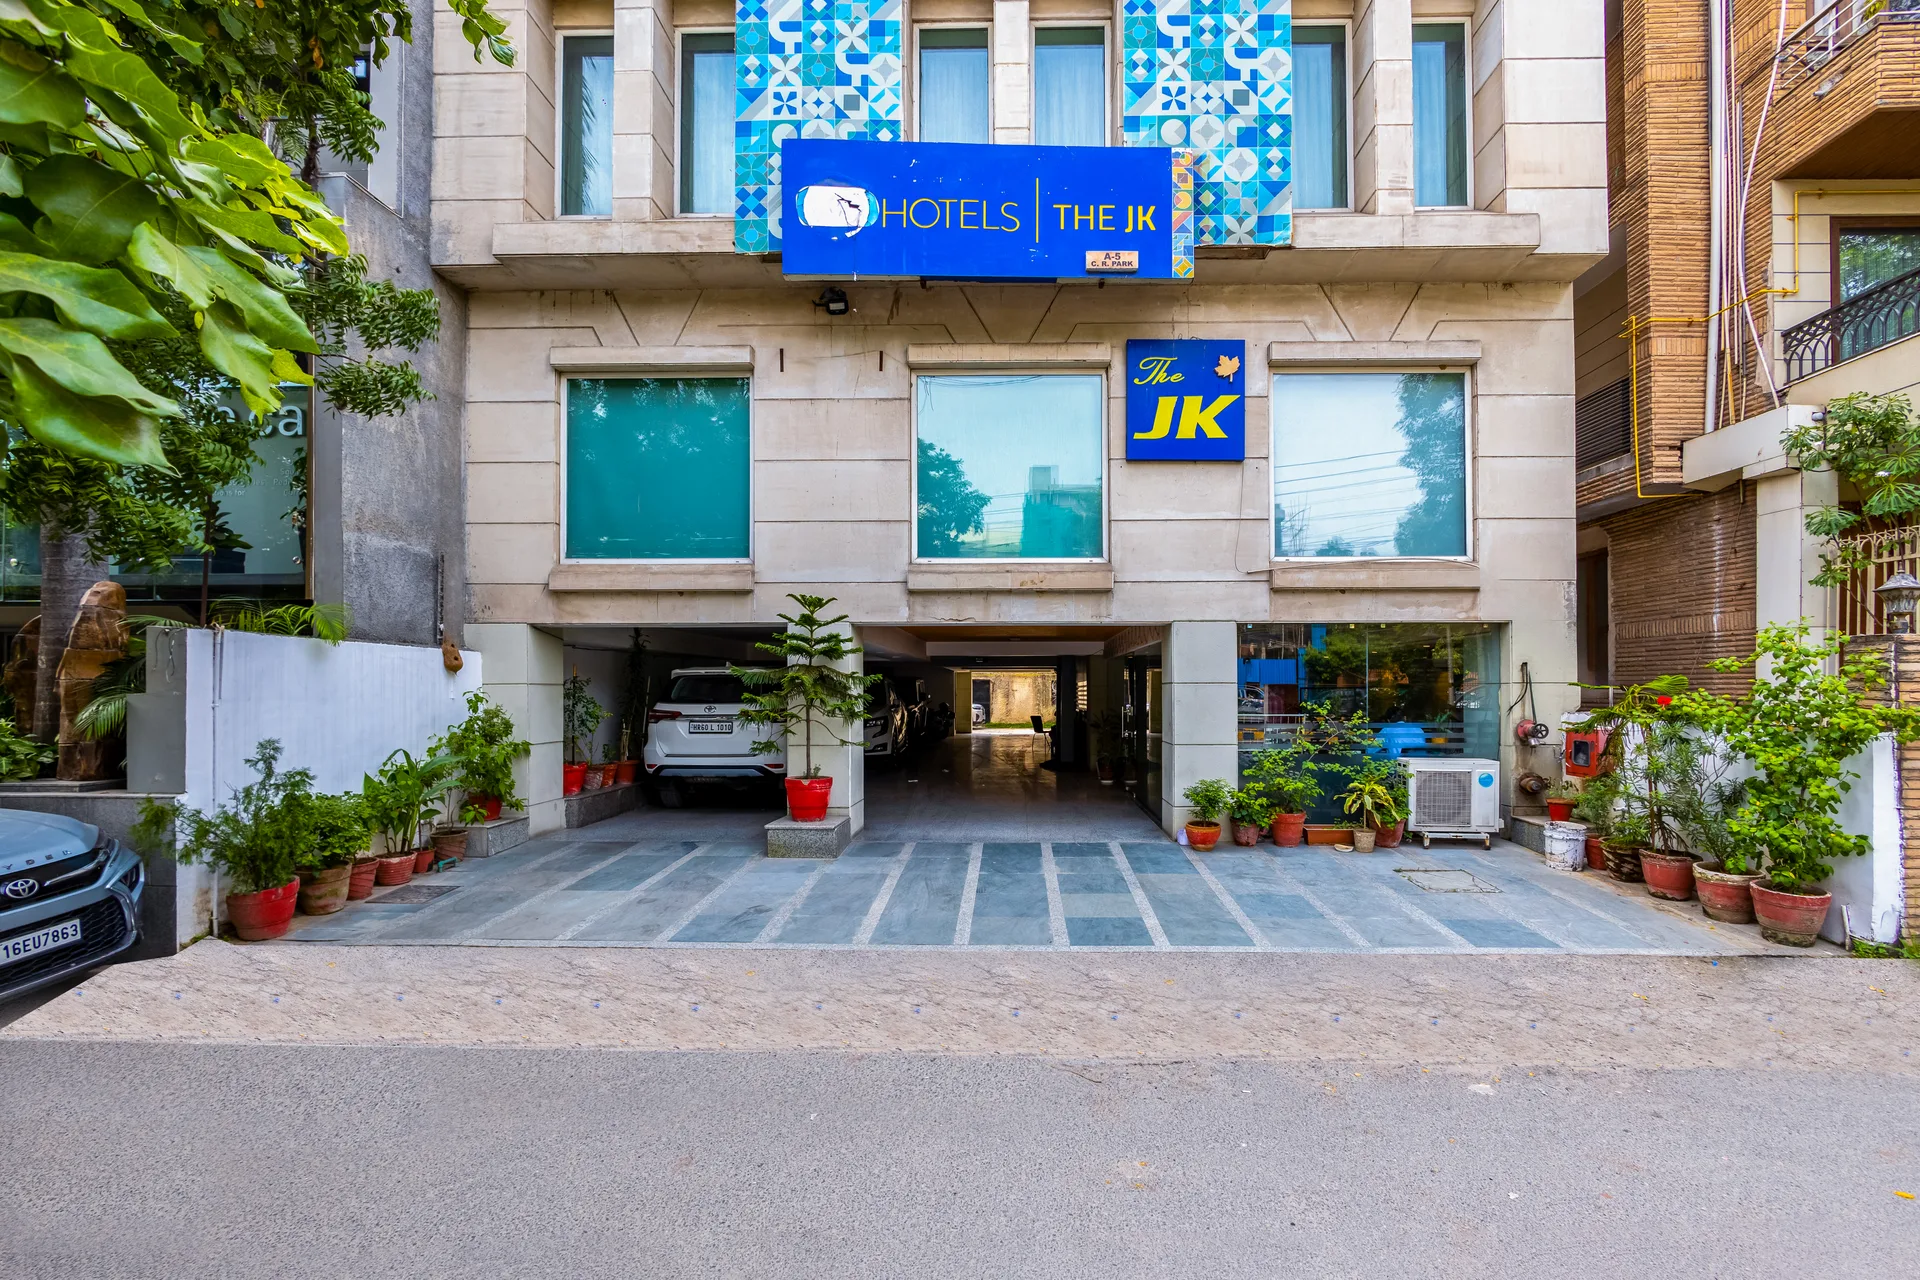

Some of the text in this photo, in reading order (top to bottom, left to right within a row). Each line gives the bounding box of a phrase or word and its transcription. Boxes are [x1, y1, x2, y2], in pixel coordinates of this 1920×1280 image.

[883, 198, 1156, 233] HOTELS THE JK
[1104, 252, 1121, 260] A-5
[1133, 356, 1185, 385] The
[1133, 395, 1241, 439] JK
[693, 723, 708, 731] HR60
[717, 723, 731, 731] 1010
